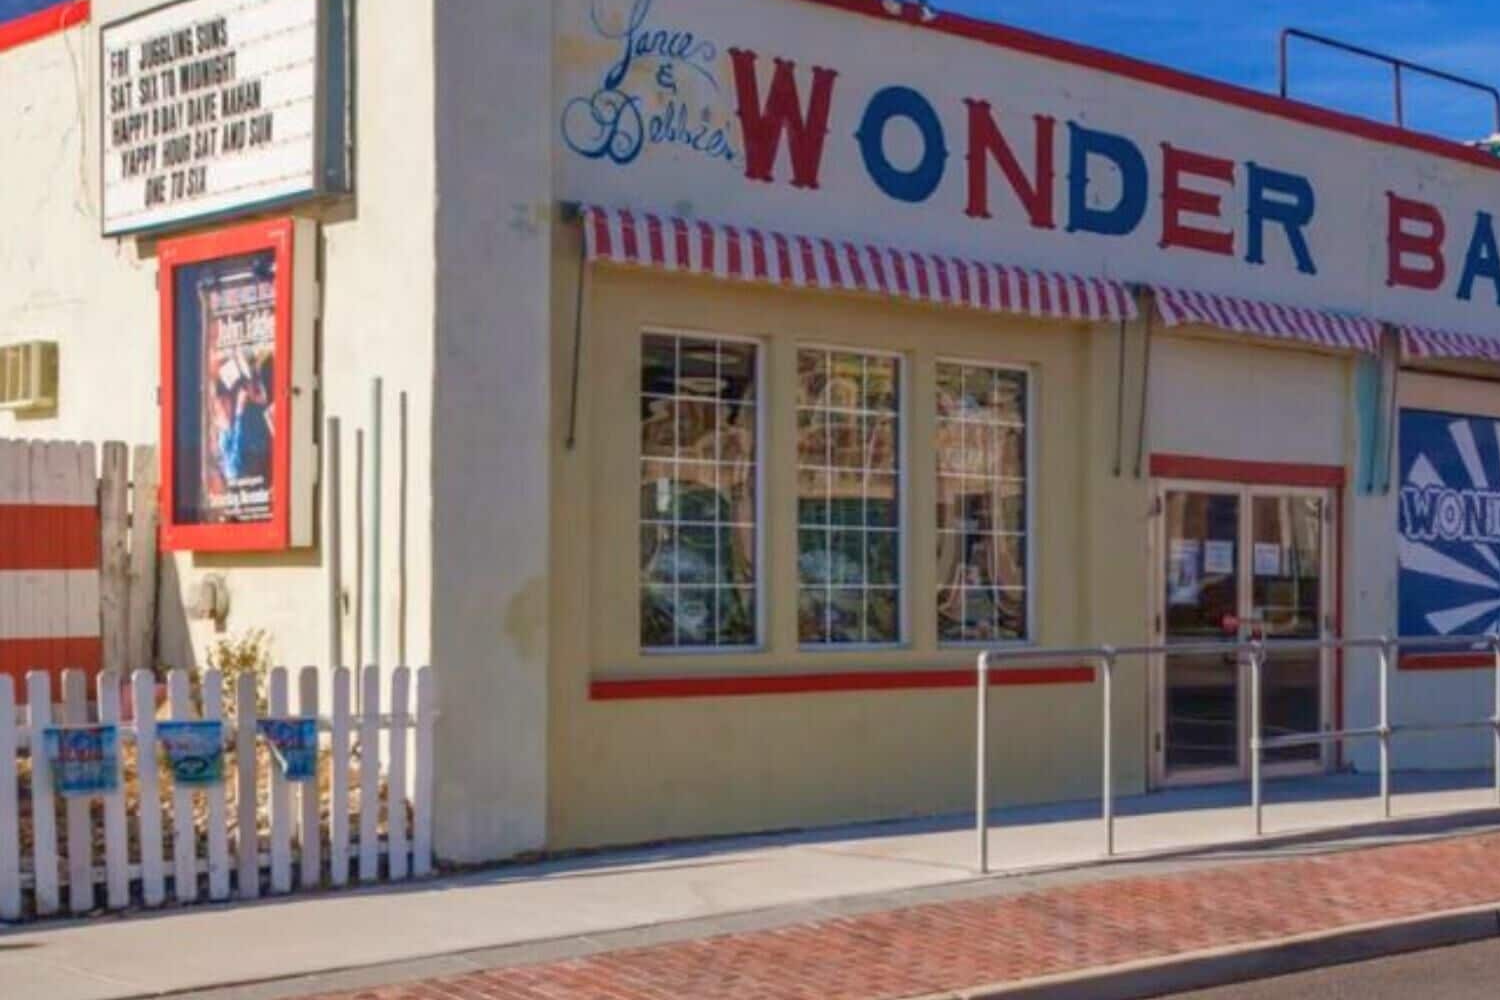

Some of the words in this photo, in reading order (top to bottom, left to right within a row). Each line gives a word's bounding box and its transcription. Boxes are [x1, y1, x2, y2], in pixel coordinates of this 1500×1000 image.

[110, 81, 132, 114] SAT
[161, 69, 176, 98] TO
[179, 52, 236, 93] MIDNIGHT
[656, 63, 678, 93] &
[112, 108, 149, 146] HAPPY
[187, 93, 217, 127] DAVE
[121, 144, 157, 178] YAPPY
[162, 134, 191, 168] HOUR
[194, 128, 217, 159] SAT
[222, 121, 246, 152] AND
[249, 112, 273, 147] SUN
[145, 176, 166, 206] ONE
[171, 171, 184, 200] TO
[187, 166, 206, 196] SIX
[727, 47, 1316, 274] WONDER
